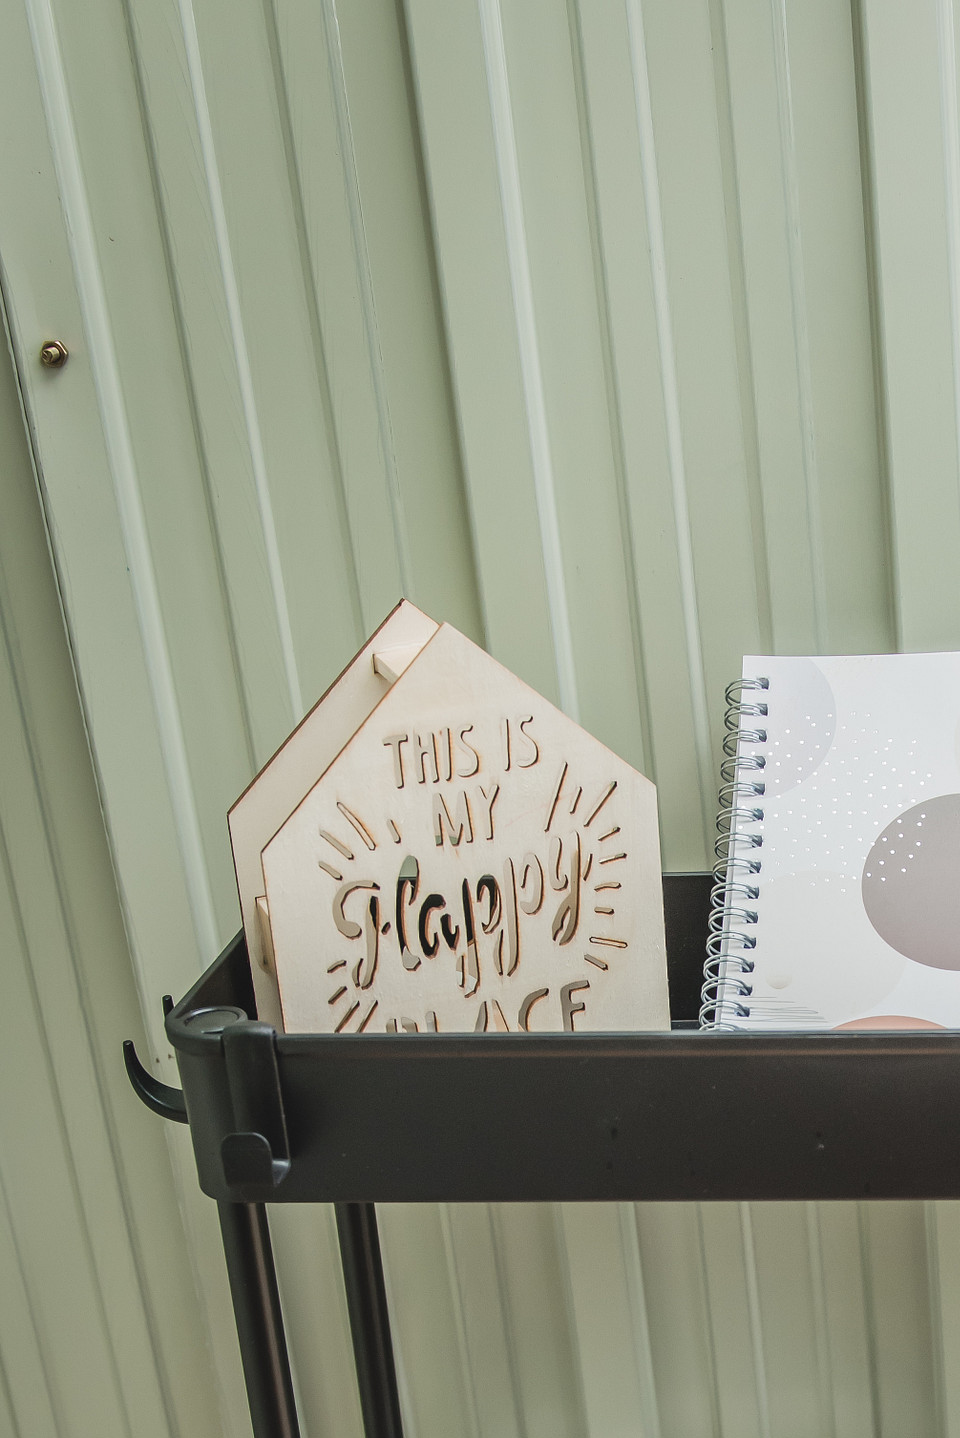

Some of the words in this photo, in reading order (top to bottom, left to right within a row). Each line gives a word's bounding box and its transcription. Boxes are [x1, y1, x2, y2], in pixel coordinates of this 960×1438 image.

[382, 723, 480, 789] THIS
[500, 714, 539, 772] IS
[432, 783, 501, 847] MY
